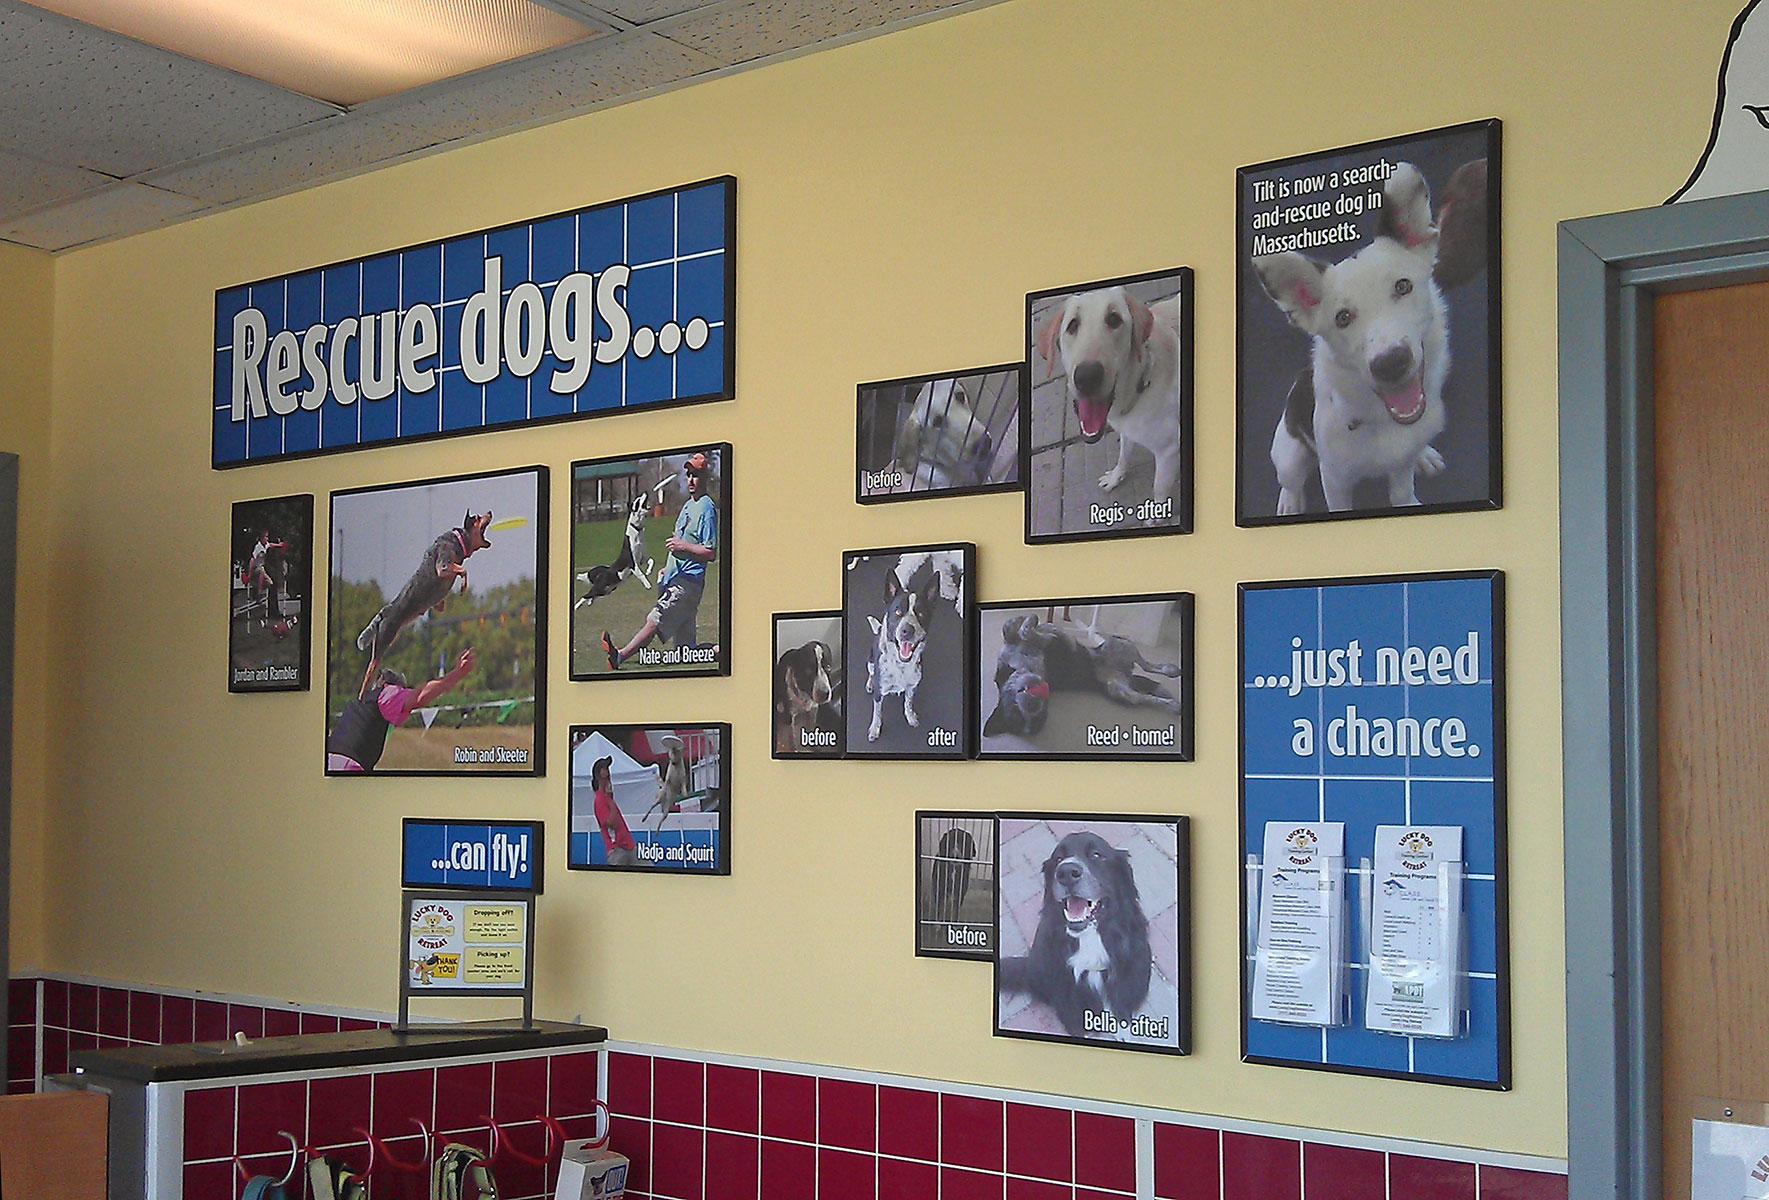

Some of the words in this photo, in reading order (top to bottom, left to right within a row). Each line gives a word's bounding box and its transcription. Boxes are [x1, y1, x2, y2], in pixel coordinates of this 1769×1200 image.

[1252, 180, 1275, 203] Tilt
[1278, 177, 1290, 198] is
[1294, 174, 1325, 195] now
[1329, 172, 1339, 189] a
[1342, 158, 1396, 187] search-
[1252, 200, 1331, 230] and-rescue
[1335, 193, 1363, 216] dog
[1367, 188, 1382, 210] in
[1252, 221, 1361, 256] Massachusetts.
[231, 302, 438, 422] Rescue
[459, 254, 709, 394] dogs...
[867, 469, 901, 489] before
[1090, 502, 1124, 526] Regis
[1136, 497, 1172, 520] after!
[639, 647, 661, 665] Nate
[663, 646, 680, 664] and
[682, 645, 714, 663] Breeze
[1254, 636, 1362, 697] ...just
[1376, 631, 1479, 686] need
[233, 667, 255, 684] Jordan
[256, 666, 269, 681] and
[270, 665, 298, 680] Rambler
[801, 727, 837, 746] before
[927, 726, 957, 746] after
[1087, 725, 1119, 746] Reed
[1132, 725, 1174, 746] home!
[1291, 718, 1314, 757] a
[1327, 705, 1480, 758] chance.
[454, 746, 478, 763] Robin
[479, 746, 495, 763] and
[496, 746, 528, 763] Skeeter
[1285, 828, 1305, 843] LUCKY
[1306, 829, 1318, 843] DOG
[1398, 831, 1419, 847] LUCKY
[1420, 833, 1433, 847] DOG
[492, 833, 528, 879] fly!
[637, 842, 664, 863] Nadja
[666, 843, 684, 861] and
[686, 843, 714, 864] Squirt
[411, 904, 436, 922] LUCKY
[437, 905, 454, 922] DOG
[417, 937, 448, 950] RETREAT
[947, 925, 987, 947] before
[436, 957, 458, 965] THANK
[437, 965, 456, 973] YOU!
[1084, 1009, 1117, 1033] Bella
[1131, 1014, 1168, 1038] after!
